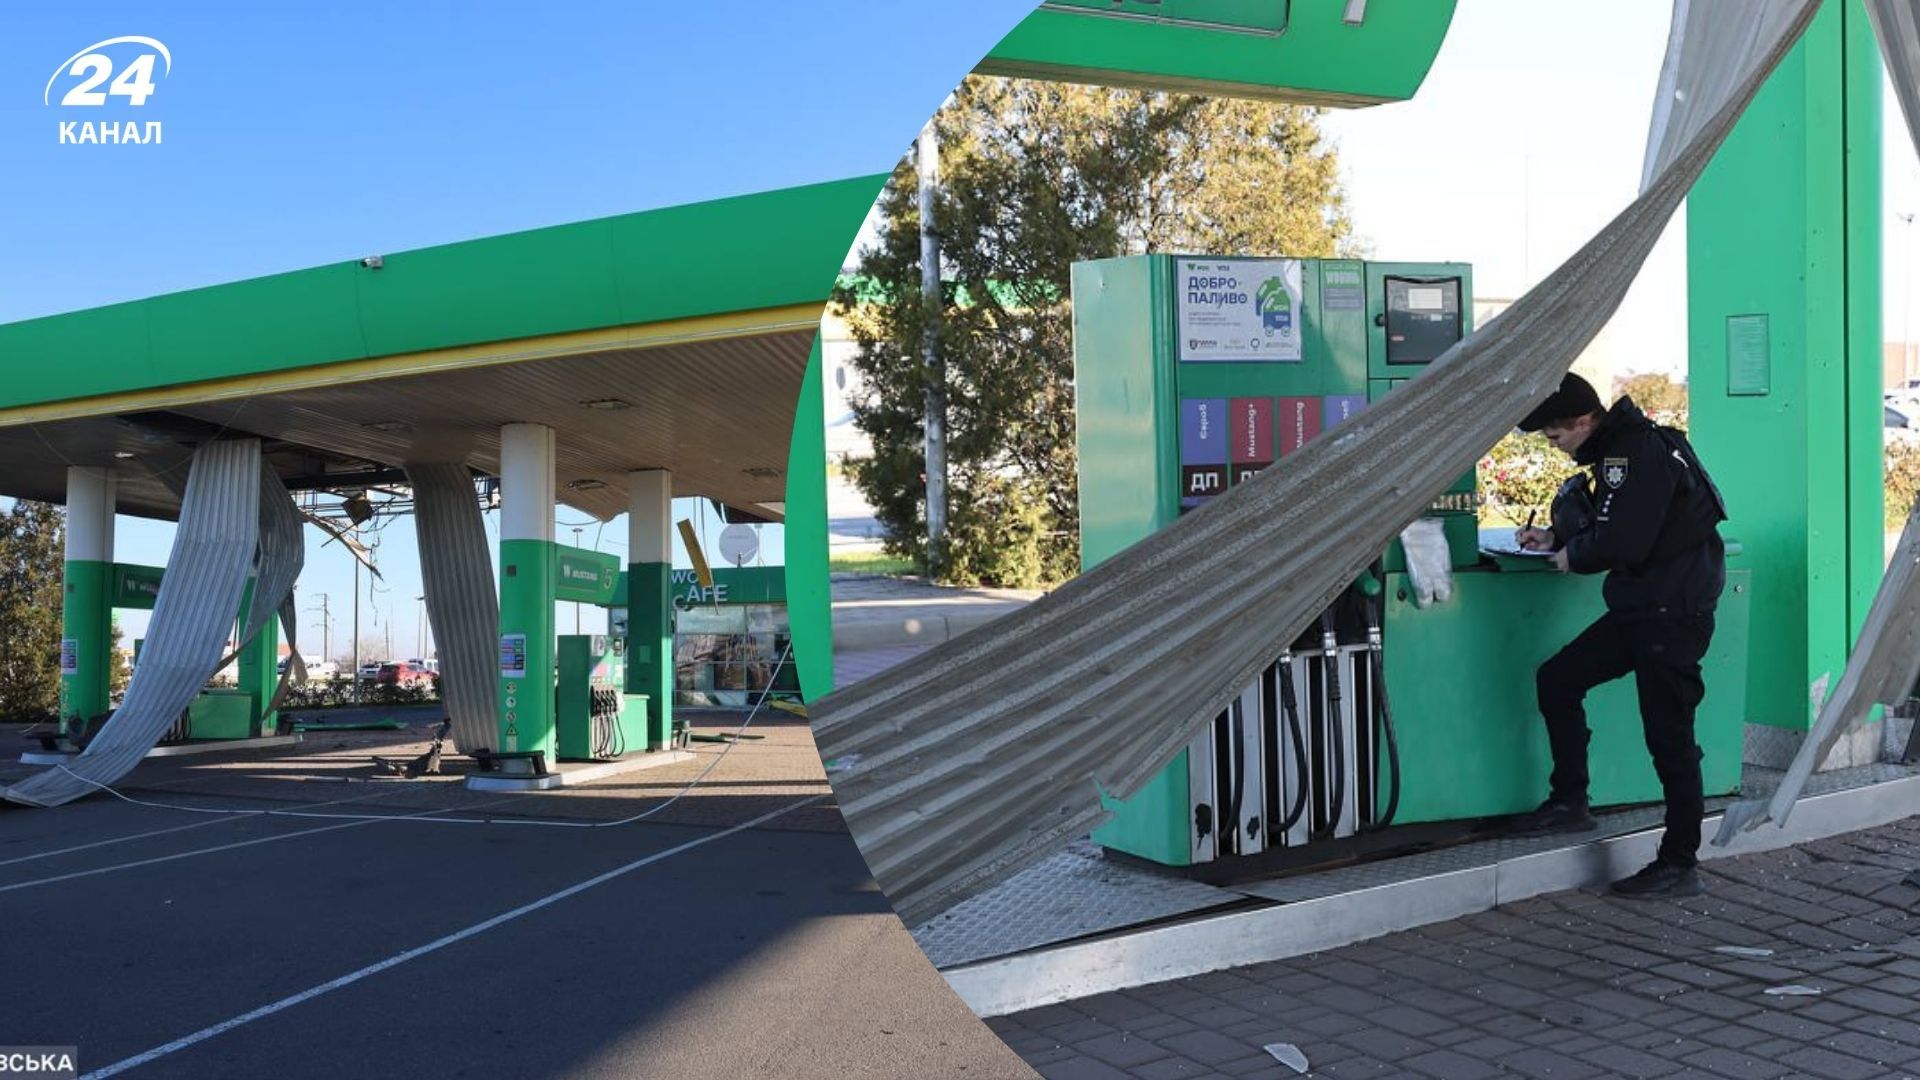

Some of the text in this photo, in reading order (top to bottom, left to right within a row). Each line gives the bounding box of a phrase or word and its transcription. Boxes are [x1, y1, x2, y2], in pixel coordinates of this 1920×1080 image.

[1188, 292, 1248, 308] ПАЛИВО
[1247, 403, 1257, 457] Mustang+
[1191, 472, 1219, 492] ДП
[603, 568, 613, 589] 5
[672, 570, 700, 584] WO
[673, 584, 728, 611] CAFE
